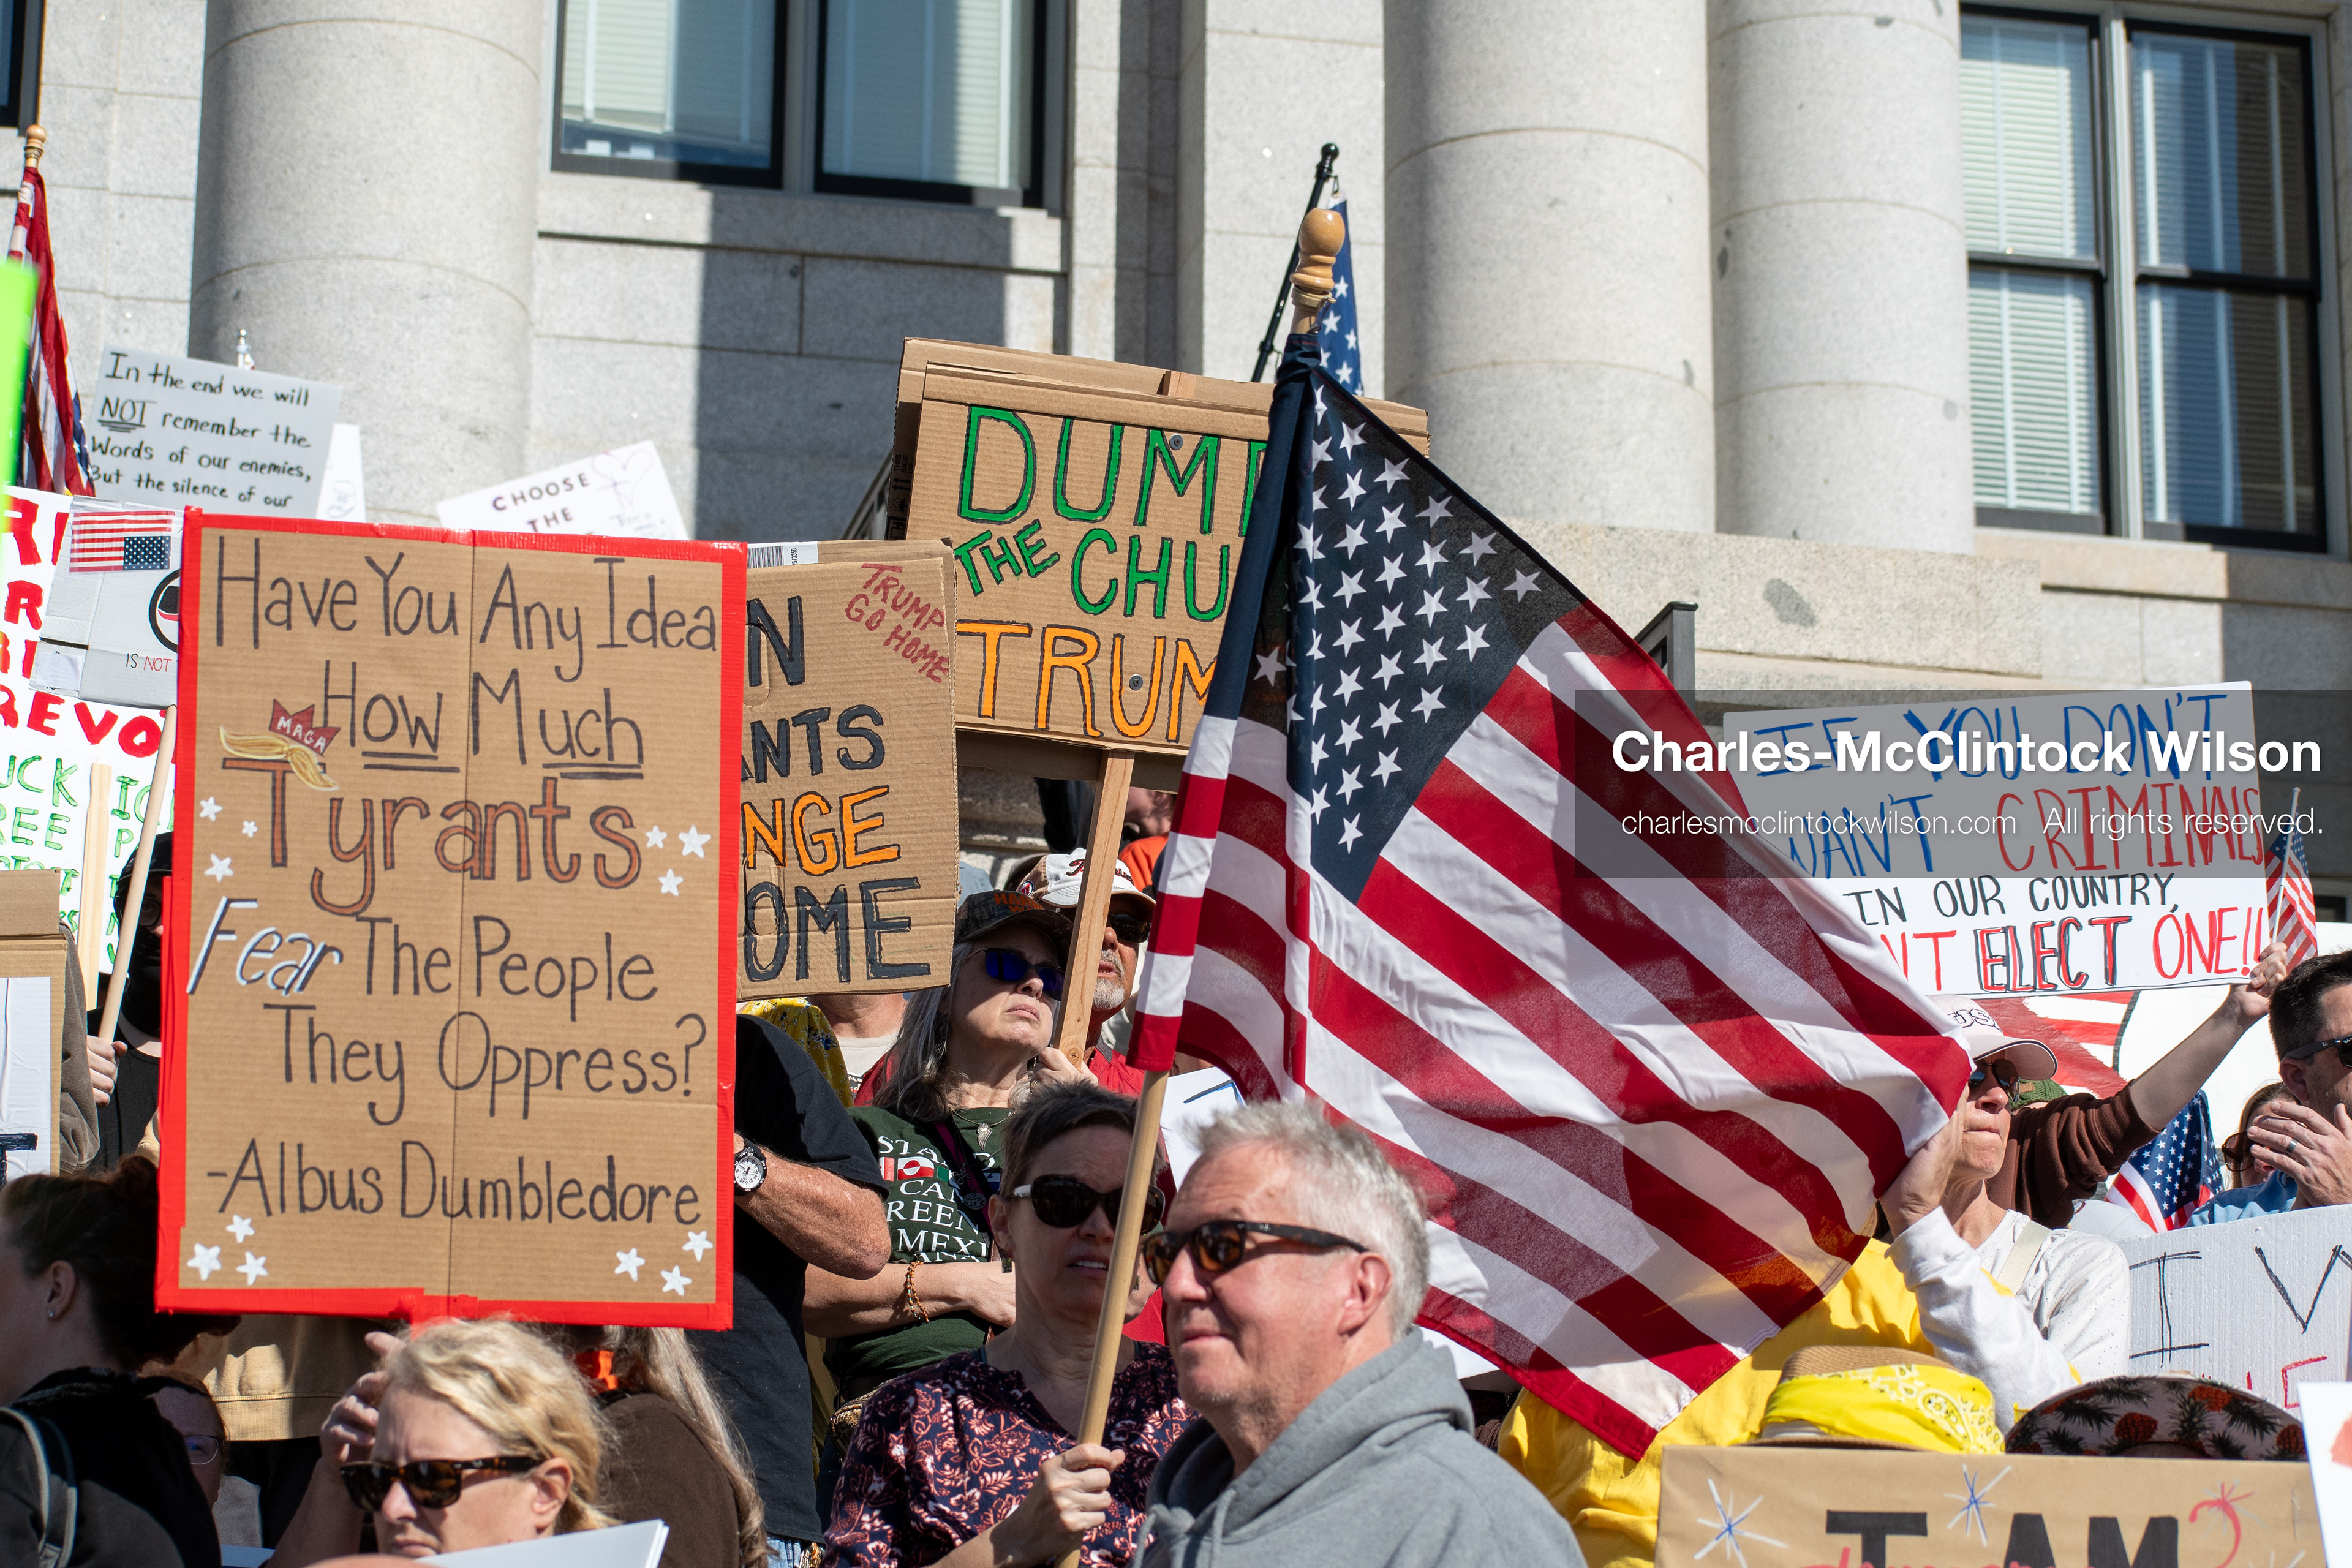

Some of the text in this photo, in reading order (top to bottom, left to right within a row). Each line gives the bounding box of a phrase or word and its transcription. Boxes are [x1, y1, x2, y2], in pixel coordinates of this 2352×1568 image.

[105, 352, 309, 407] In the end we will
[92, 435, 311, 483] Words of our enemies,
[100, 396, 311, 448] NOT remember the
[133, 473, 165, 491] the
[172, 477, 228, 498] silence
[238, 486, 256, 502] of
[264, 495, 293, 507] our
[492, 473, 589, 511] CHOOSE
[527, 507, 574, 533] THE
[954, 519, 1060, 596] THE
[217, 536, 718, 682] Have You Any Idea
[861, 562, 946, 632] TRUMP
[126, 653, 173, 672] IS NOT
[845, 593, 950, 684] GO HOME
[276, 715, 328, 753] MAGA
[472, 668, 644, 766] Much
[1903, 706, 2022, 782] YOU
[2063, 693, 2228, 781] DON'T
[221, 758, 642, 916] Tyrants
[1997, 783, 2264, 871] CRIMINALS
[1842, 872, 2179, 926] IN OUR COUNTRY,
[185, 896, 658, 1022] Fear The People
[1973, 915, 2133, 993] ELECT
[263, 1002, 707, 1126] They Oppress?
[206, 1138, 702, 1225] -Albus Dumbledore
